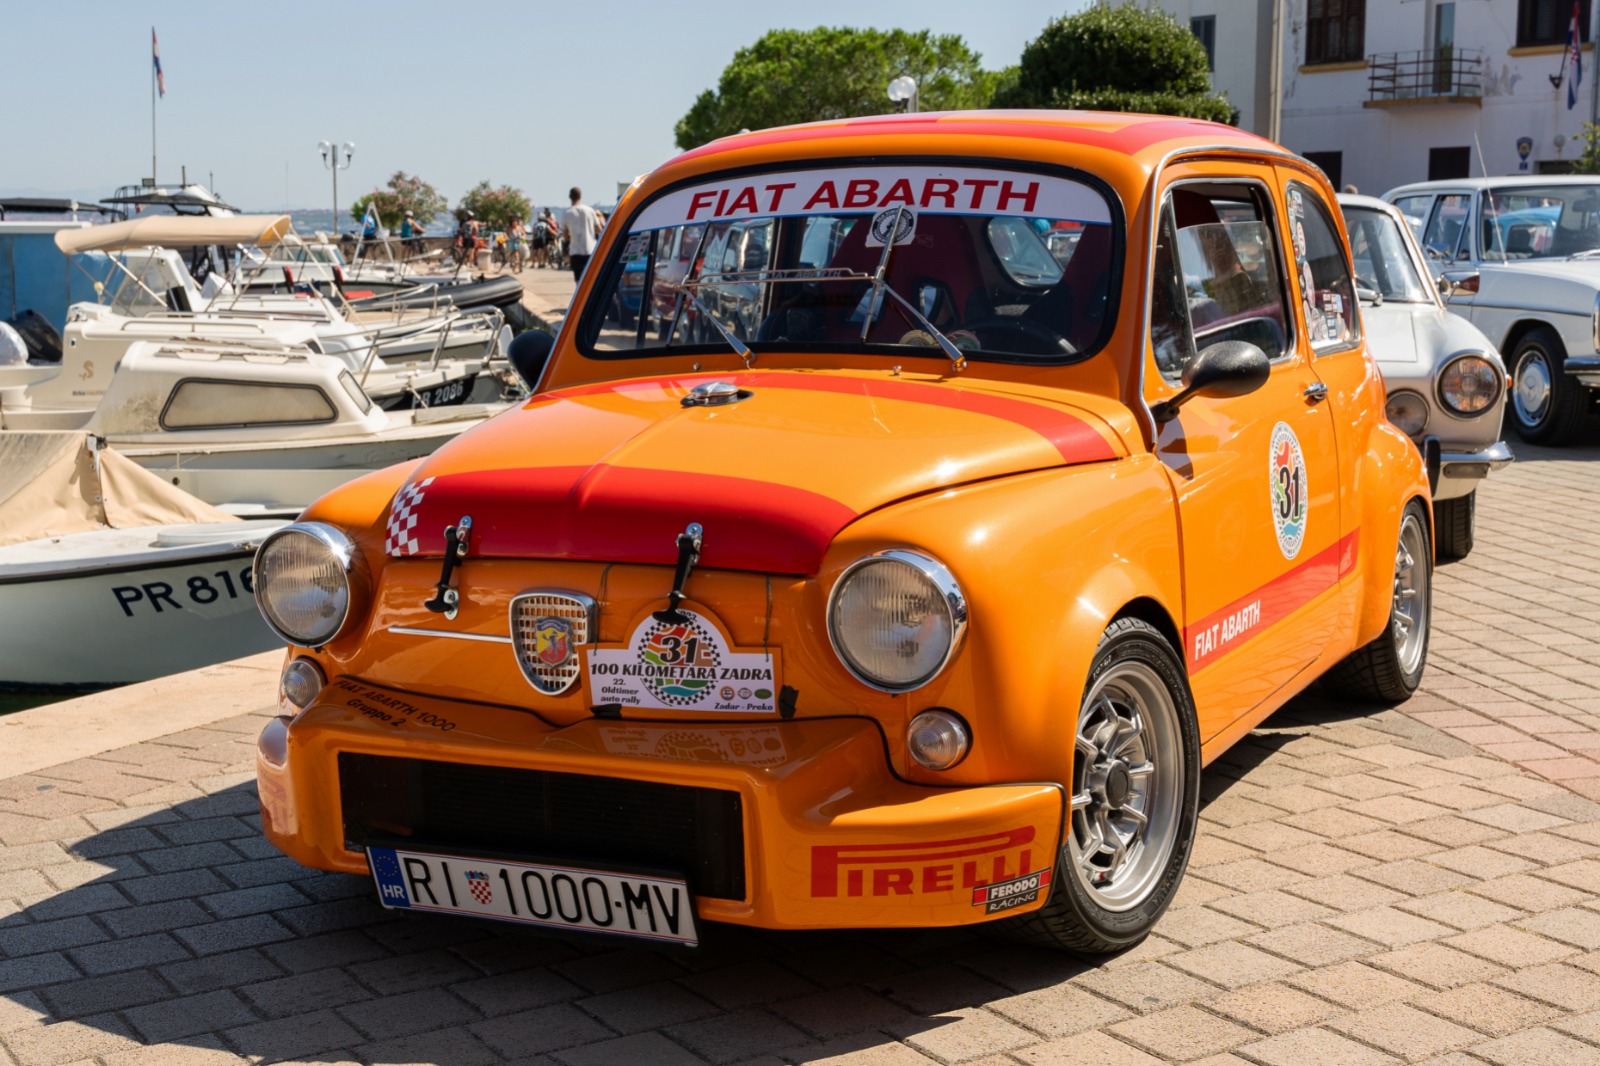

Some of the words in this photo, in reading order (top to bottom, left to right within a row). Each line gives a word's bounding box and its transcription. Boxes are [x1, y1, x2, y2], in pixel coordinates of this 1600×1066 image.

[686, 182, 796, 220] FIAT
[803, 178, 1040, 213] ABARTH
[434, 380, 464, 405] 2086
[1280, 466, 1299, 519] 31
[111, 581, 183, 617] PR
[1195, 623, 1220, 661] FIAT
[1221, 599, 1261, 646] ABARTH
[660, 636, 698, 664] 31
[591, 663, 619, 675] 100
[622, 664, 717, 679] KILOMETARA
[720, 668, 772, 680] ZADRA
[613, 678, 626, 686] 22.
[601, 686, 639, 695] Oldtimer
[621, 696, 641, 705] rally
[334, 680, 367, 694] FIAT
[362, 691, 419, 716] ABARTH
[416, 712, 456, 732] 1000
[346, 698, 392, 721] Gruppo
[390, 718, 407, 727] 2
[746, 703, 773, 711] Preko
[811, 825, 1036, 897] PIRELLI
[382, 884, 406, 899] HR
[403, 857, 458, 907] RI
[990, 876, 1038, 899] FERODO
[989, 893, 1036, 912] RACING
